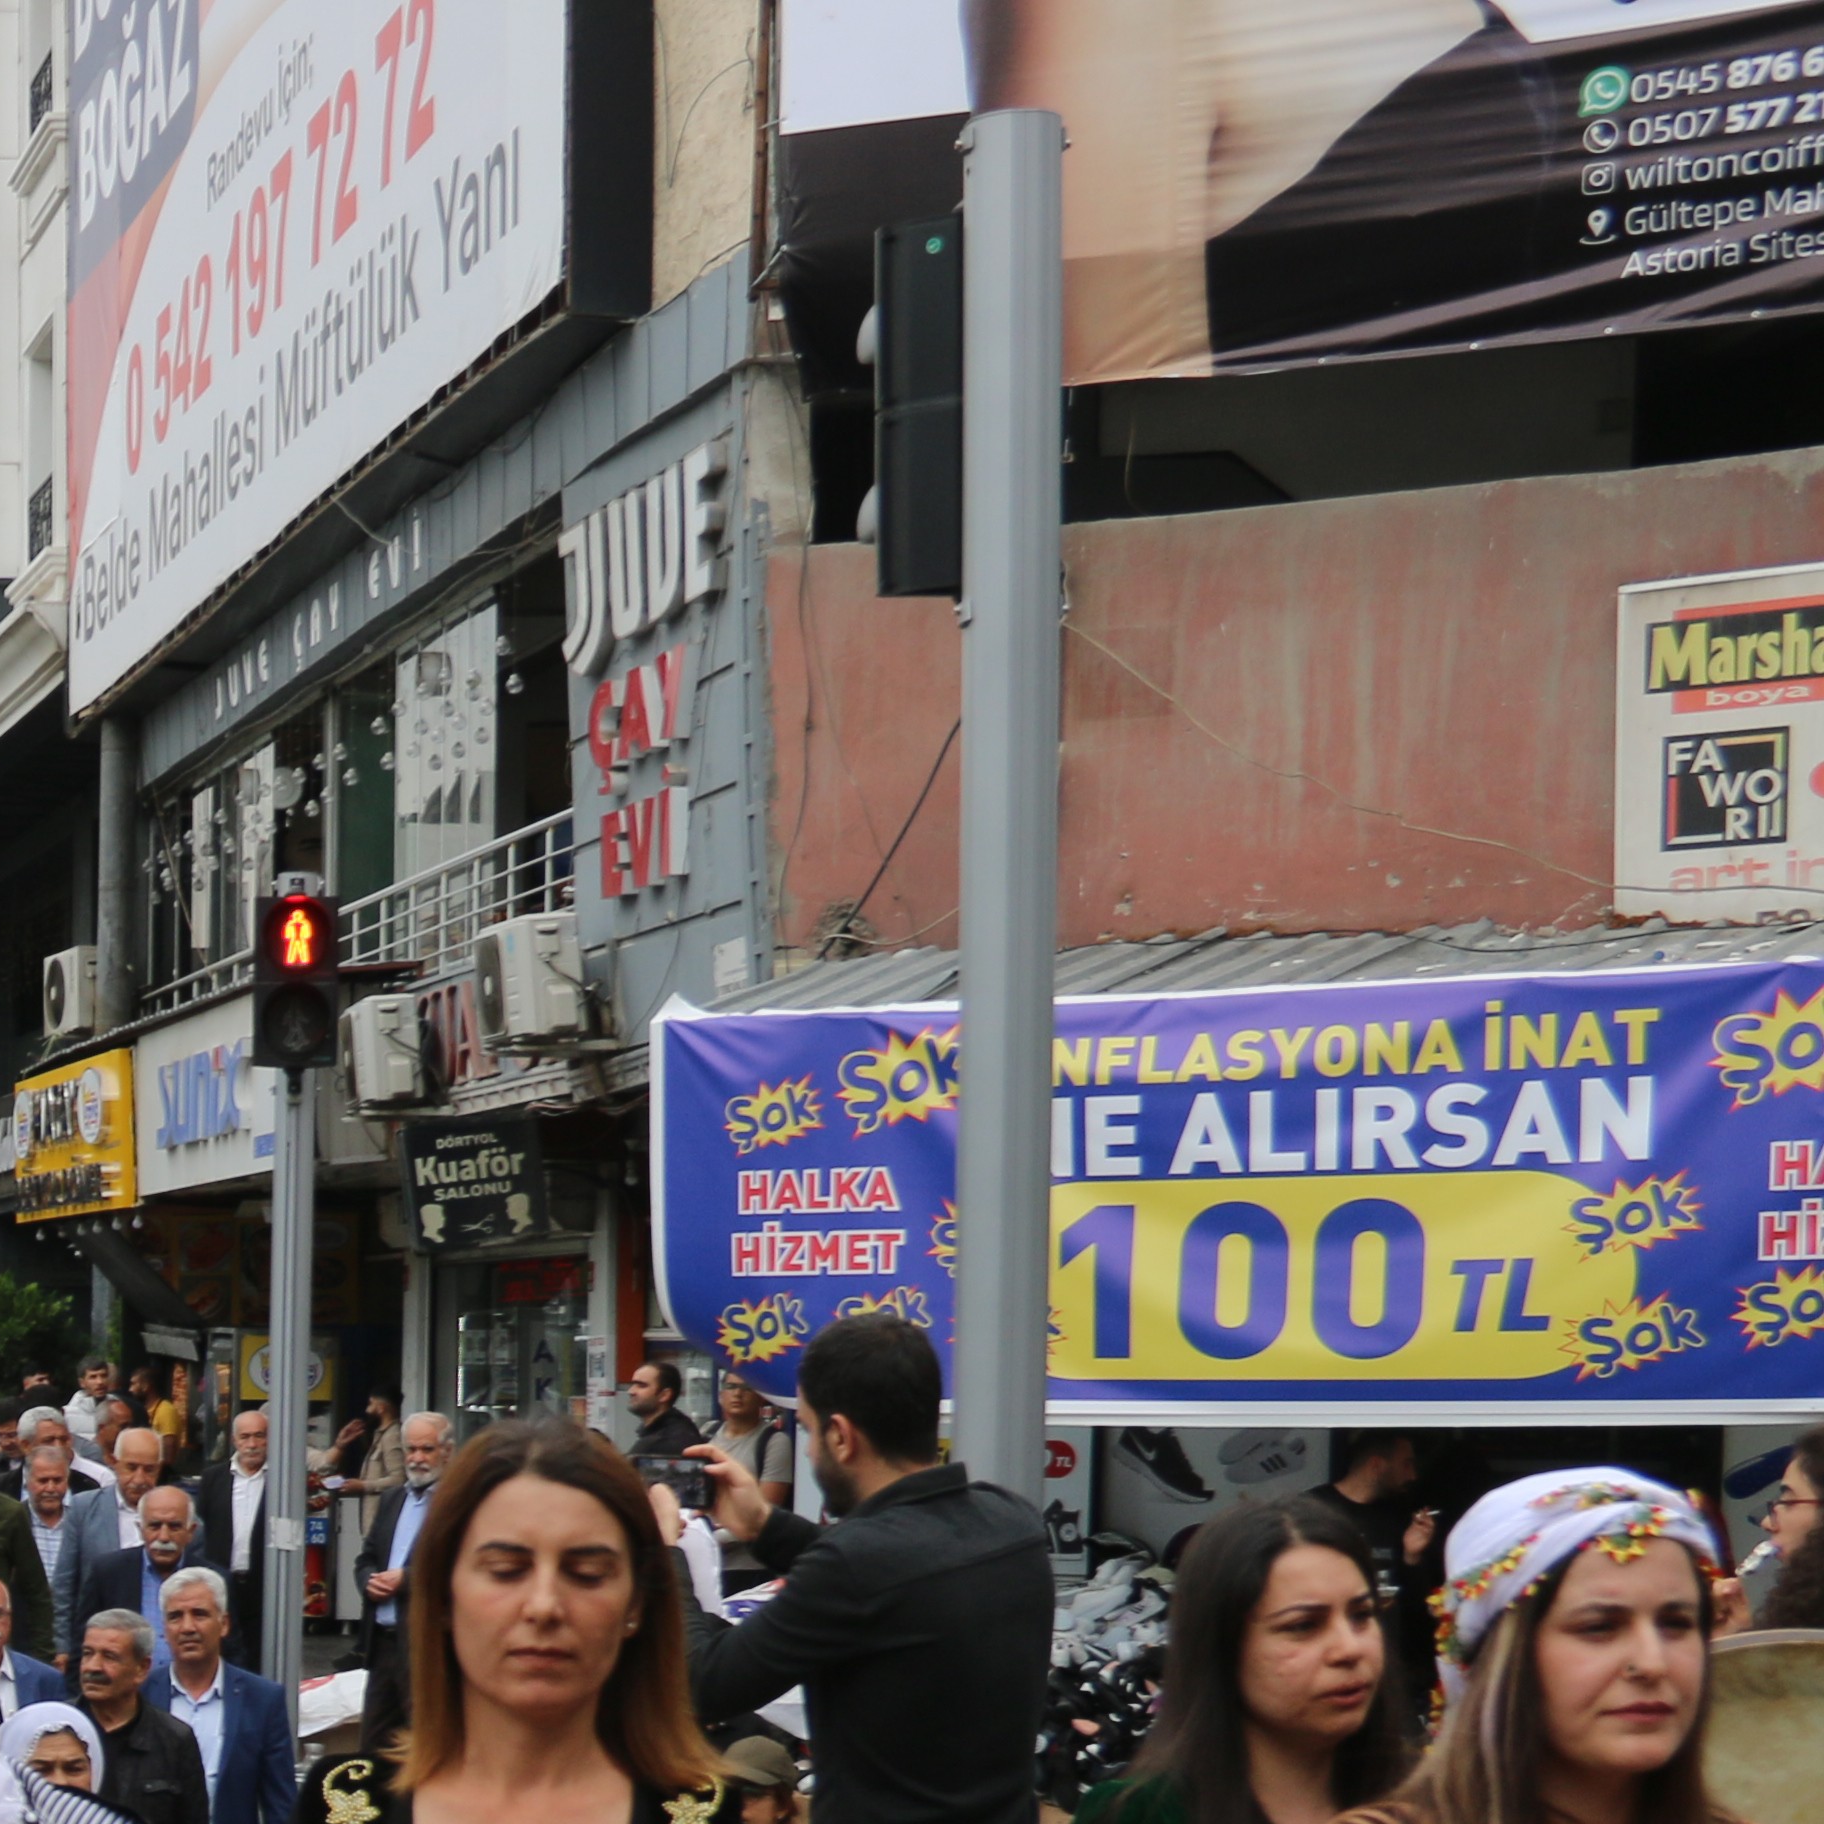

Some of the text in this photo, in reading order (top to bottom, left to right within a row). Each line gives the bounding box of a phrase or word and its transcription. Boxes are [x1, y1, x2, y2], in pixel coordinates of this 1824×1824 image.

[1630, 46, 1824, 103] 0545 876 6
[1627, 107, 1720, 146] 0507
[1724, 97, 1792, 133] 577
[206, 93, 273, 211] Randevu
[1625, 134, 1824, 190] wiltoncoiff
[126, 0, 434, 475] 0 542 197 72 72
[1624, 198, 1755, 235] Gültepe
[1620, 231, 1824, 278] Astoria Sites
[82, 126, 519, 643] Belde Mahallesi Müftülük Yanı
[216, 639, 269, 720] JUVE
[1705, 685, 1810, 706] boya
[588, 643, 697, 796] ÇAY
[1669, 858, 1772, 893] art
[1052, 1000, 1660, 1087] NFLASYONA İNAT
[1713, 1014, 1824, 1104] Şo
[435, 1133, 499, 1150] DÖRTYOL
[1169, 1075, 1653, 1175] ALIRSAN
[414, 1146, 526, 1187] Kuaför
[433, 1180, 512, 1202] SALONU
[738, 1166, 901, 1215] HALKA
[731, 1221, 906, 1277] HİZMET
[1058, 1197, 1426, 1360] 100
[1453, 1258, 1552, 1333] TL
[1747, 1281, 1824, 1347] Şo
